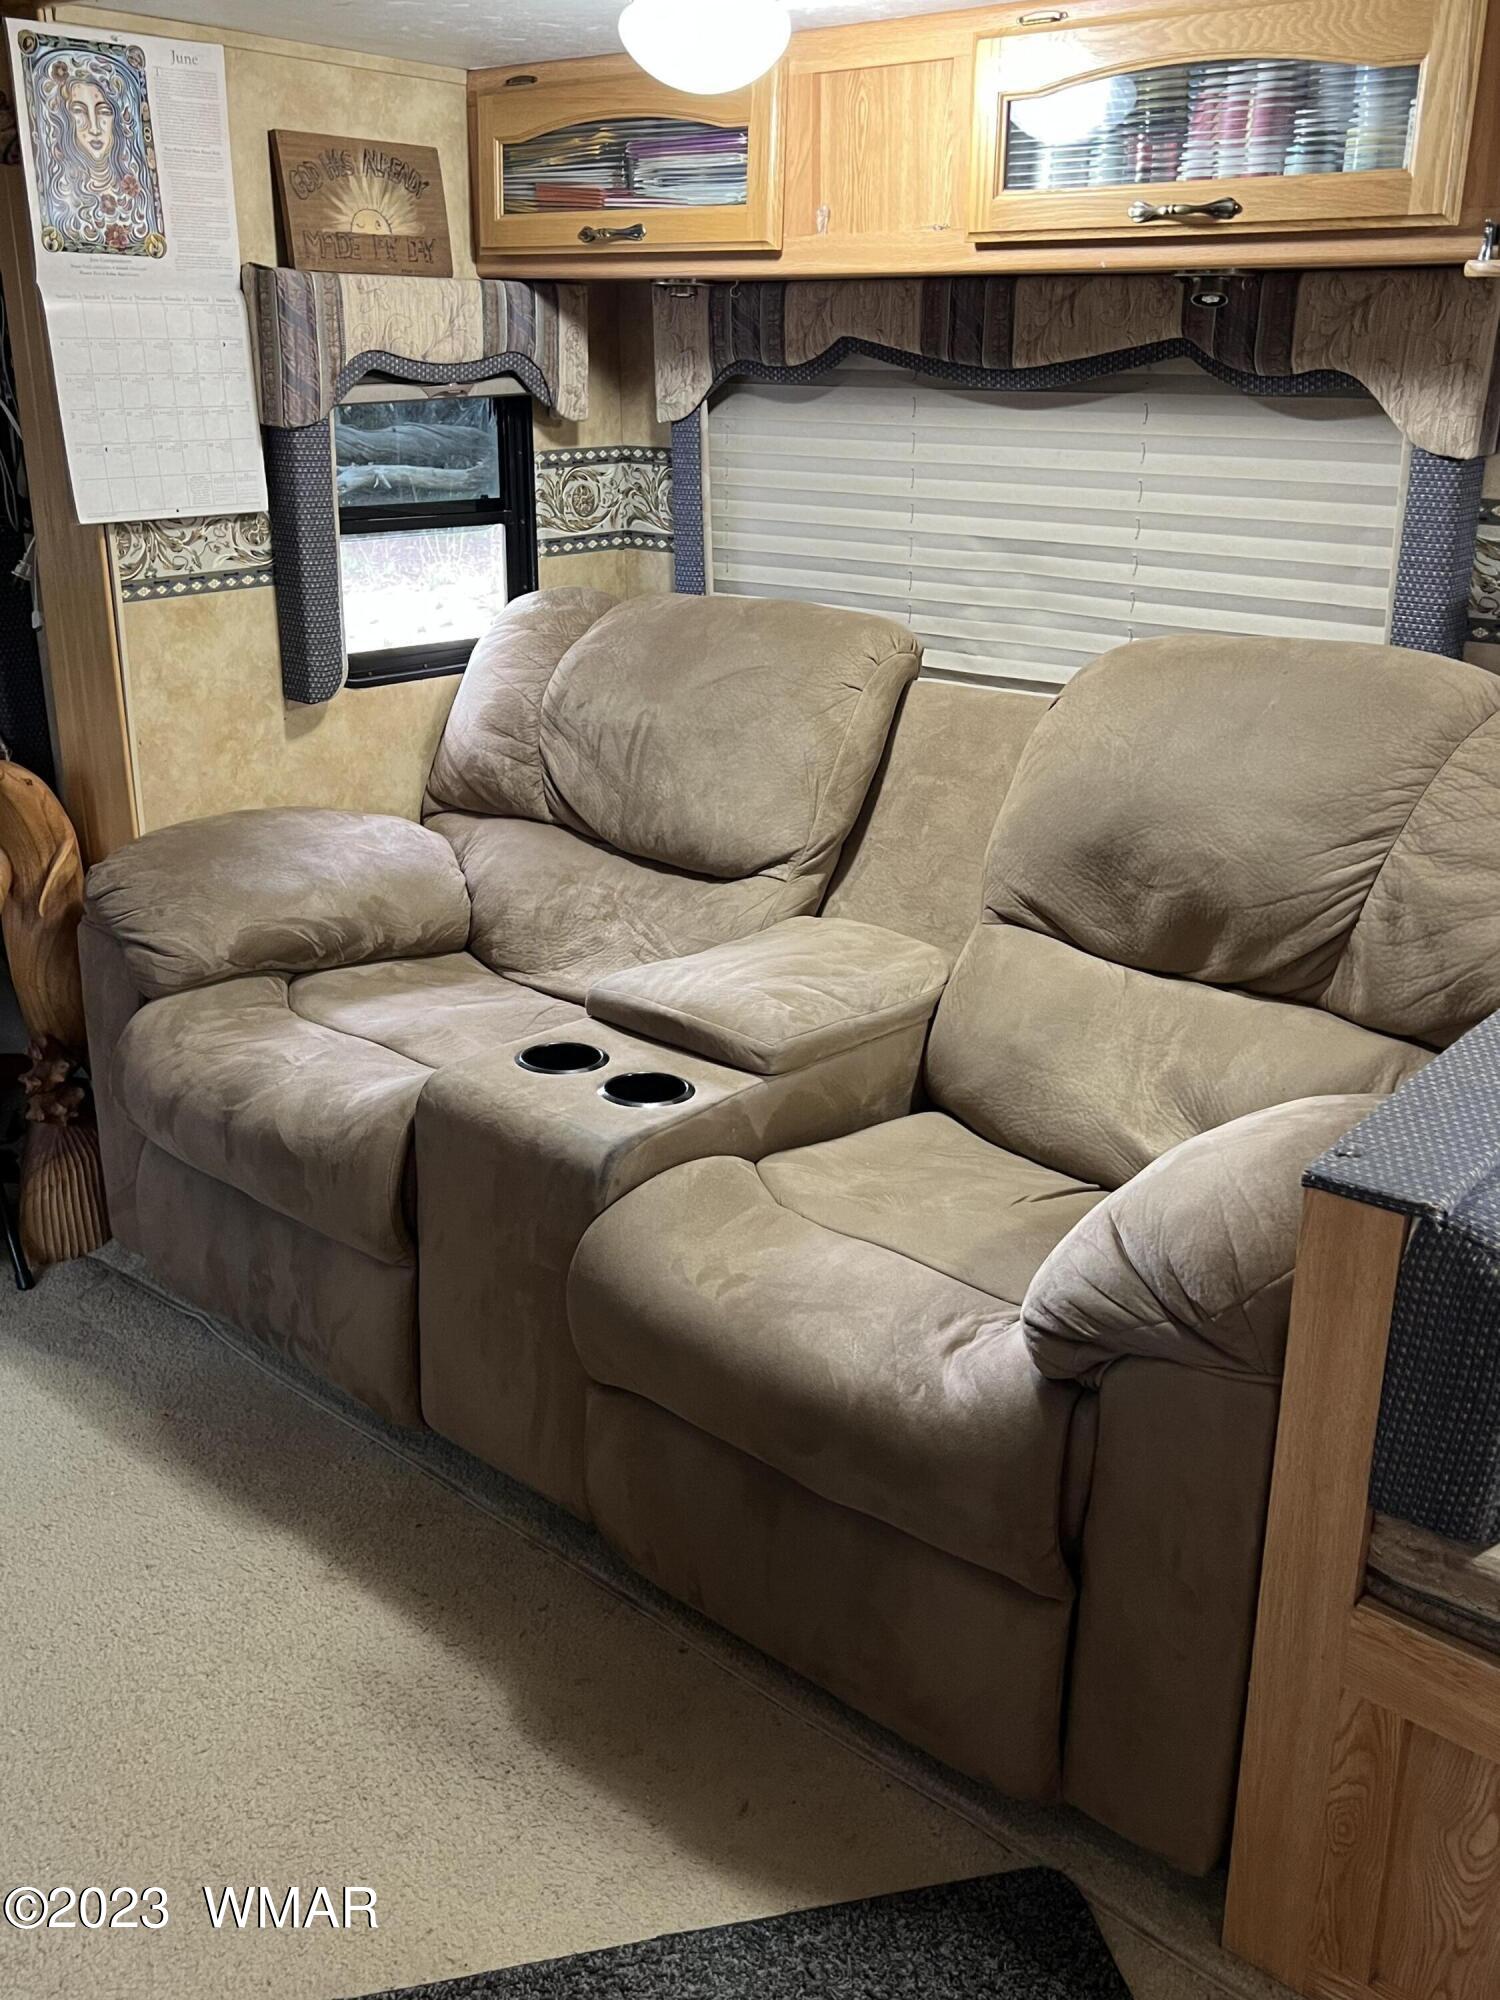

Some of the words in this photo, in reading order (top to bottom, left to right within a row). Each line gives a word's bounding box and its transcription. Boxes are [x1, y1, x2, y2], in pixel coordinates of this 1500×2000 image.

[170, 49, 199, 66] June
[289, 160, 323, 200] GOD
[319, 148, 355, 181] HAS
[362, 148, 430, 199] ALREADY
[302, 230, 361, 260] MADE
[406, 236, 436, 265] DAY
